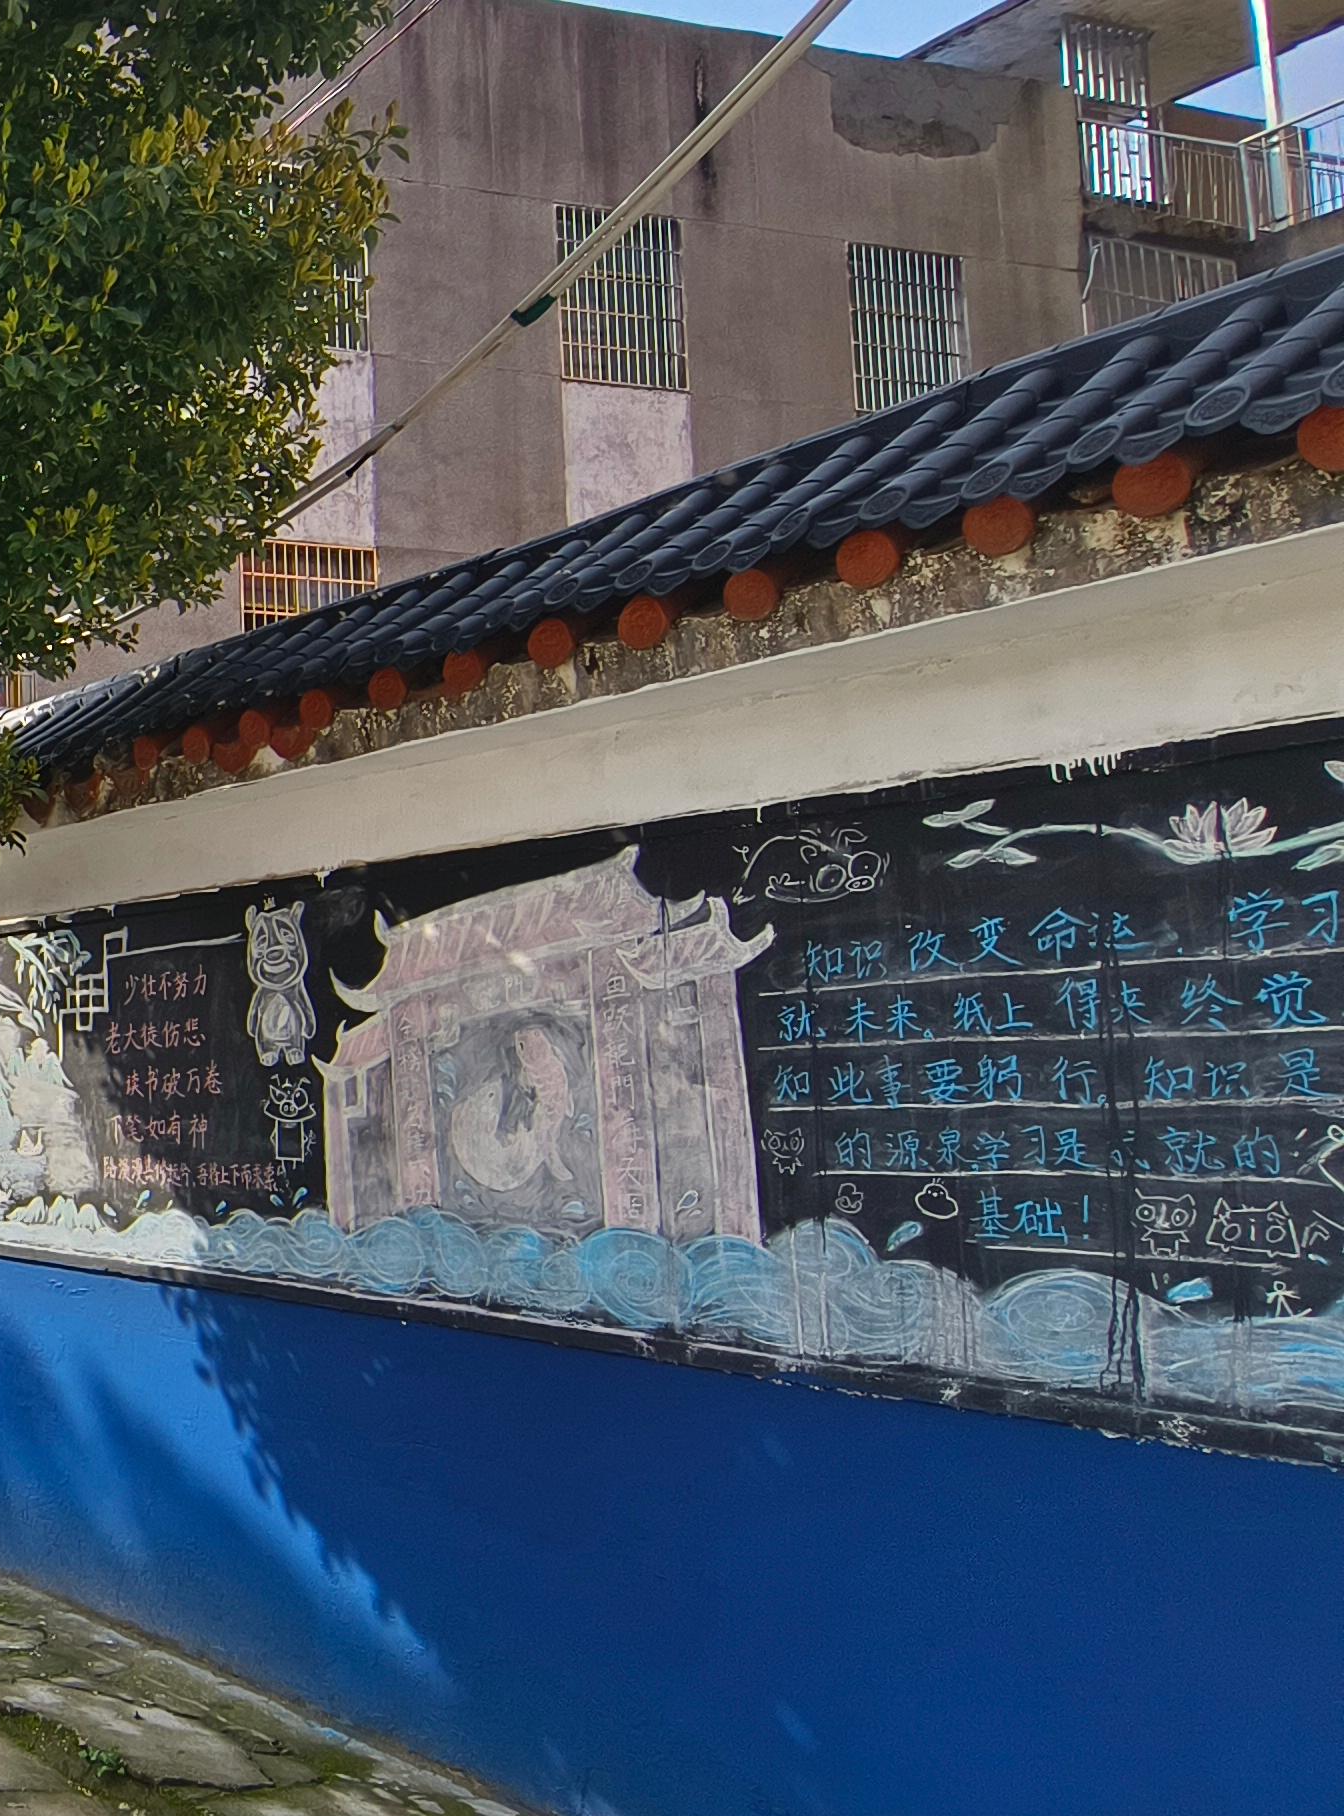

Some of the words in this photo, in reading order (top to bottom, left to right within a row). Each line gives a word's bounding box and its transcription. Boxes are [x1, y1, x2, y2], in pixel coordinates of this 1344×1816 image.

[123, 964, 207, 1006] 少壮不努力
[104, 1017, 206, 1055] 老大徒伤悲
[125, 1059, 223, 1103] 读书破万卷
[106, 1109, 209, 1150] 下笔如有神
